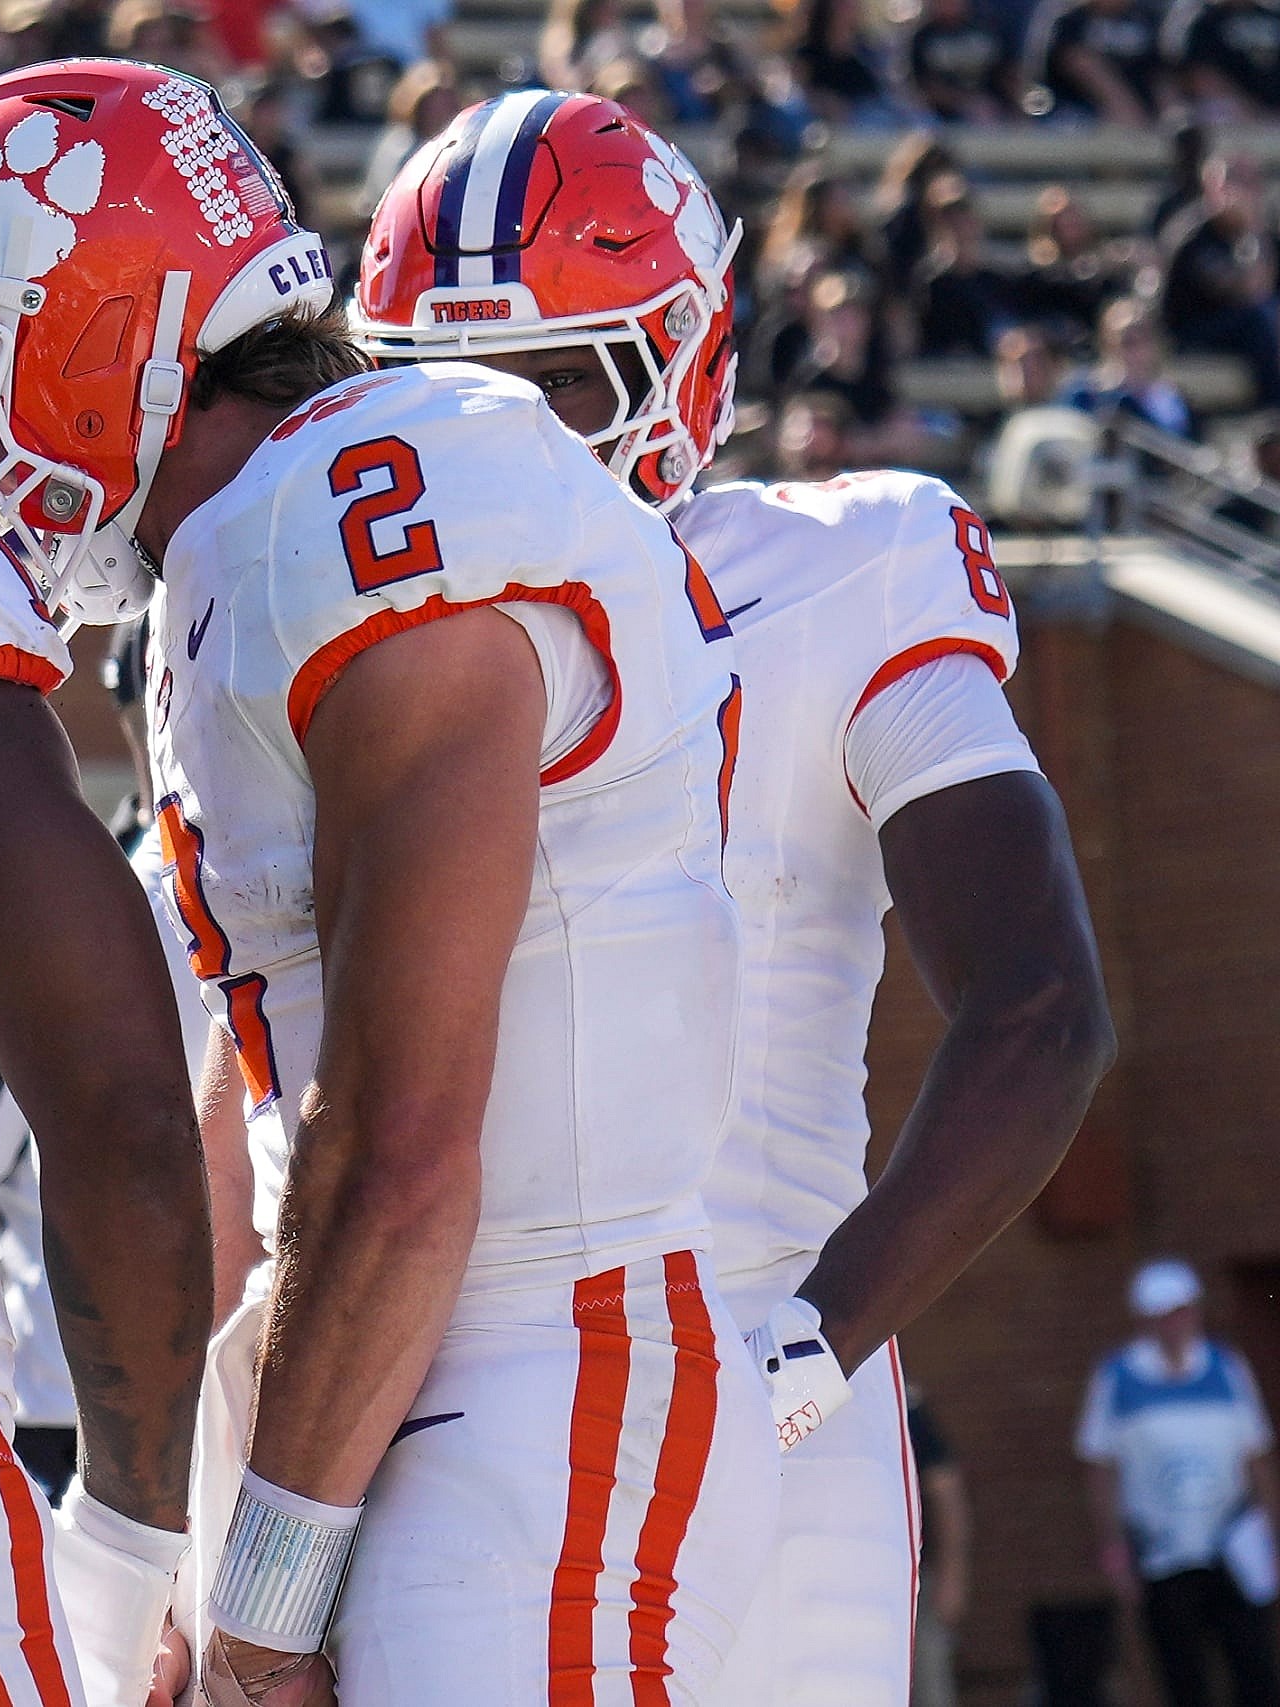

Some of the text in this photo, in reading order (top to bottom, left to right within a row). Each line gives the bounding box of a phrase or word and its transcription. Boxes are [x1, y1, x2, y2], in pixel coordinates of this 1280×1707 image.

[431, 299, 511, 323] TIGERS
[327, 435, 444, 596] 2
[949, 505, 1010, 622] 8
